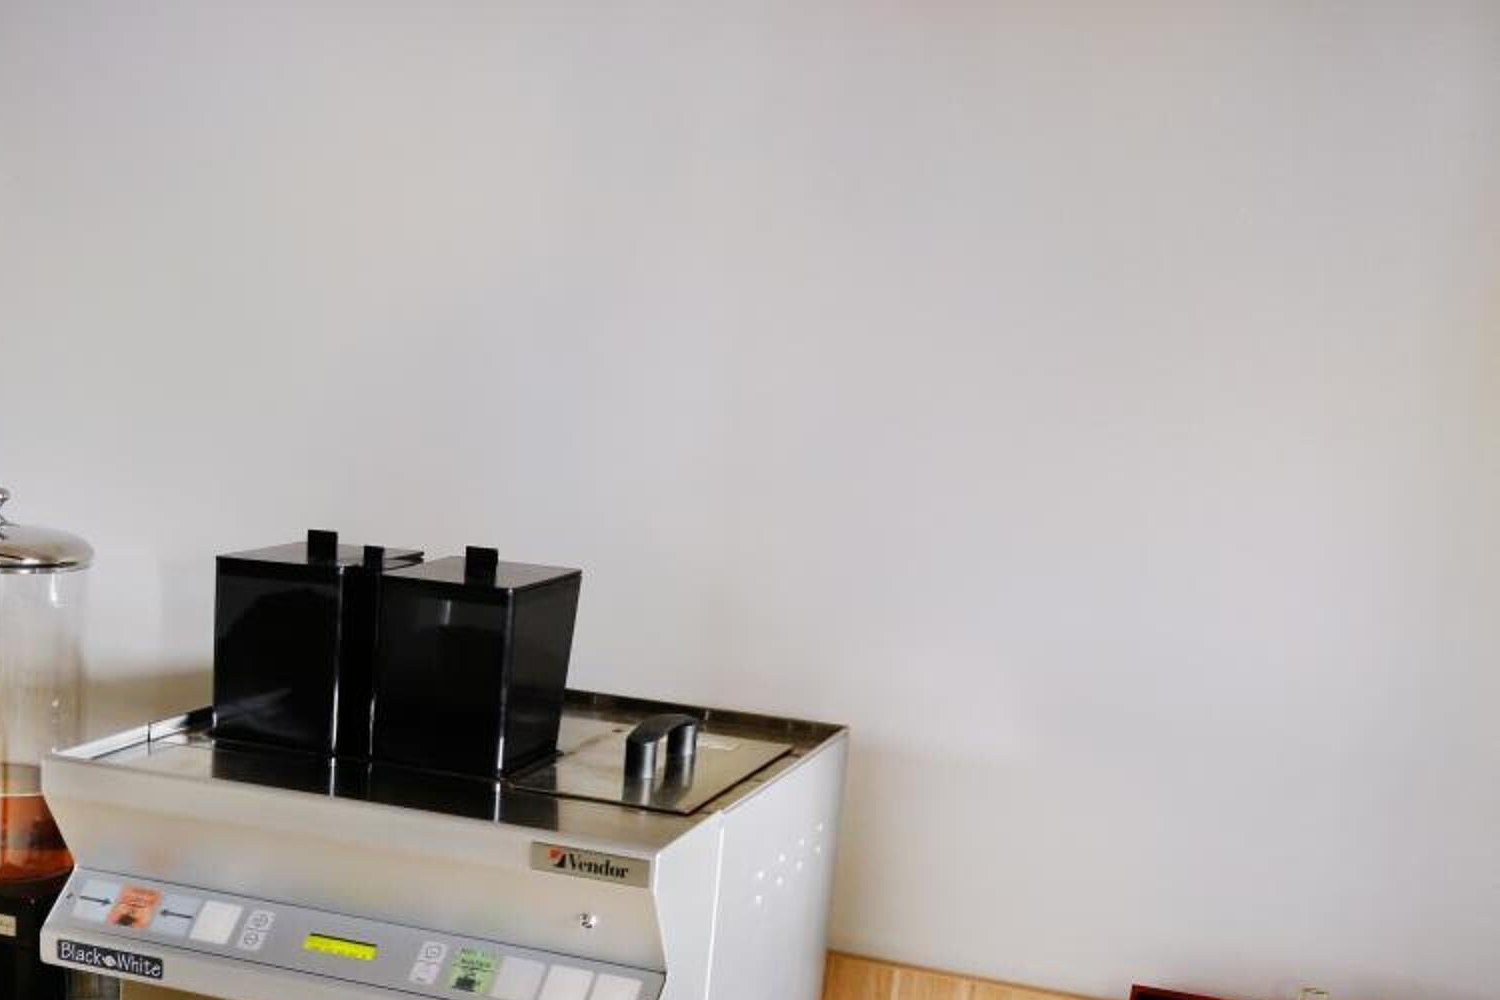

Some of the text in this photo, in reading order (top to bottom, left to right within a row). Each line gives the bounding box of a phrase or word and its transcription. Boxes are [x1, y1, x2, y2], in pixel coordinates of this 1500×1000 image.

[568, 852, 629, 878] Vendor
[60, 943, 161, 976] Black White
